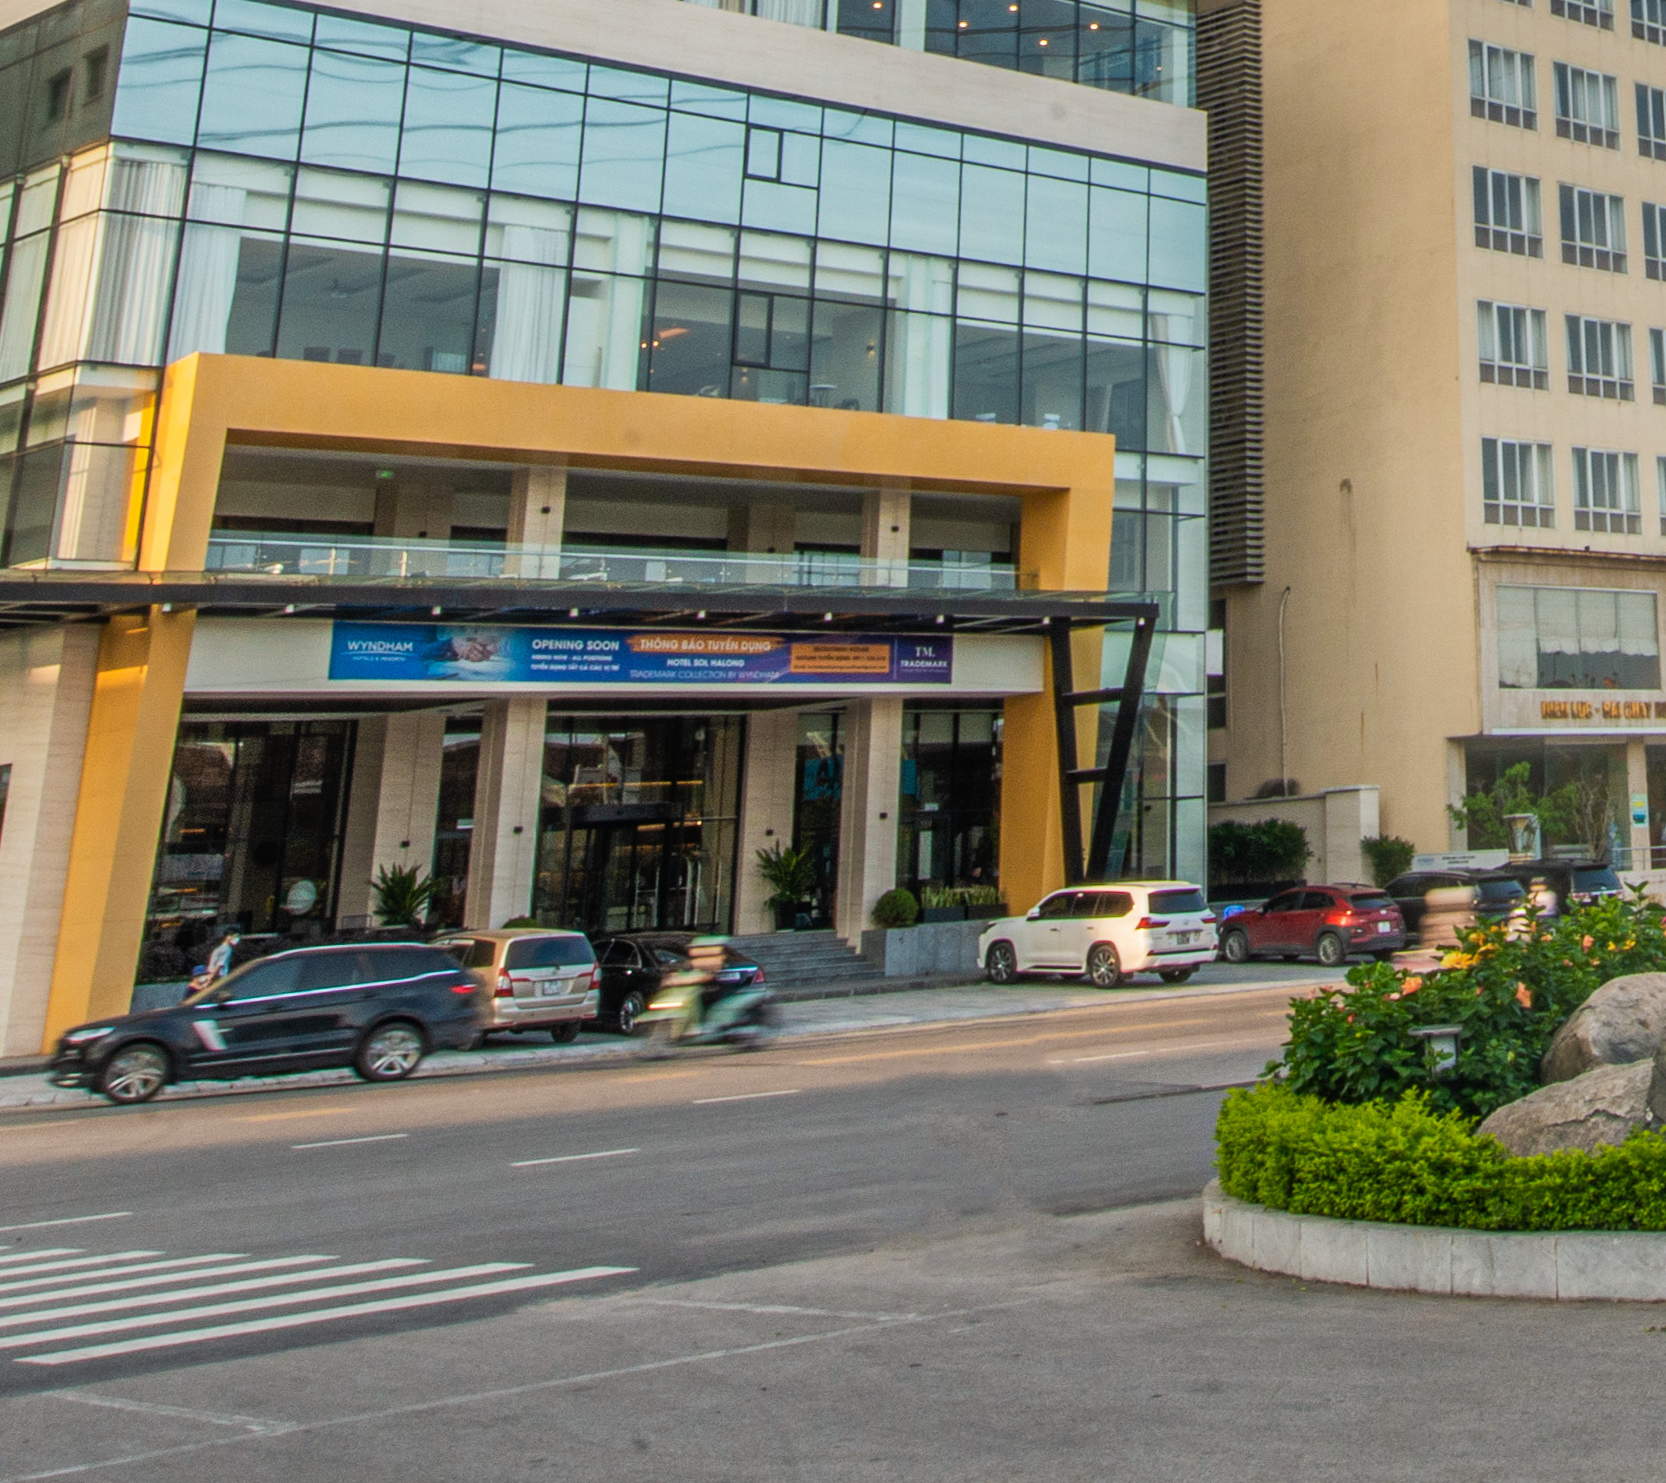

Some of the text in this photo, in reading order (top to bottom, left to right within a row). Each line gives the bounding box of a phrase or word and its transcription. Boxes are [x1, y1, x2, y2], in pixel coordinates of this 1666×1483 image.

[347, 639, 414, 652] WYNDHAM
[532, 639, 620, 651] OPENING SOON
[640, 637, 679, 650] THÔNG
[681, 637, 705, 650] BÁO
[741, 640, 772, 653] DỤNG
[667, 658, 745, 667] HOTEL SOL HALONG
